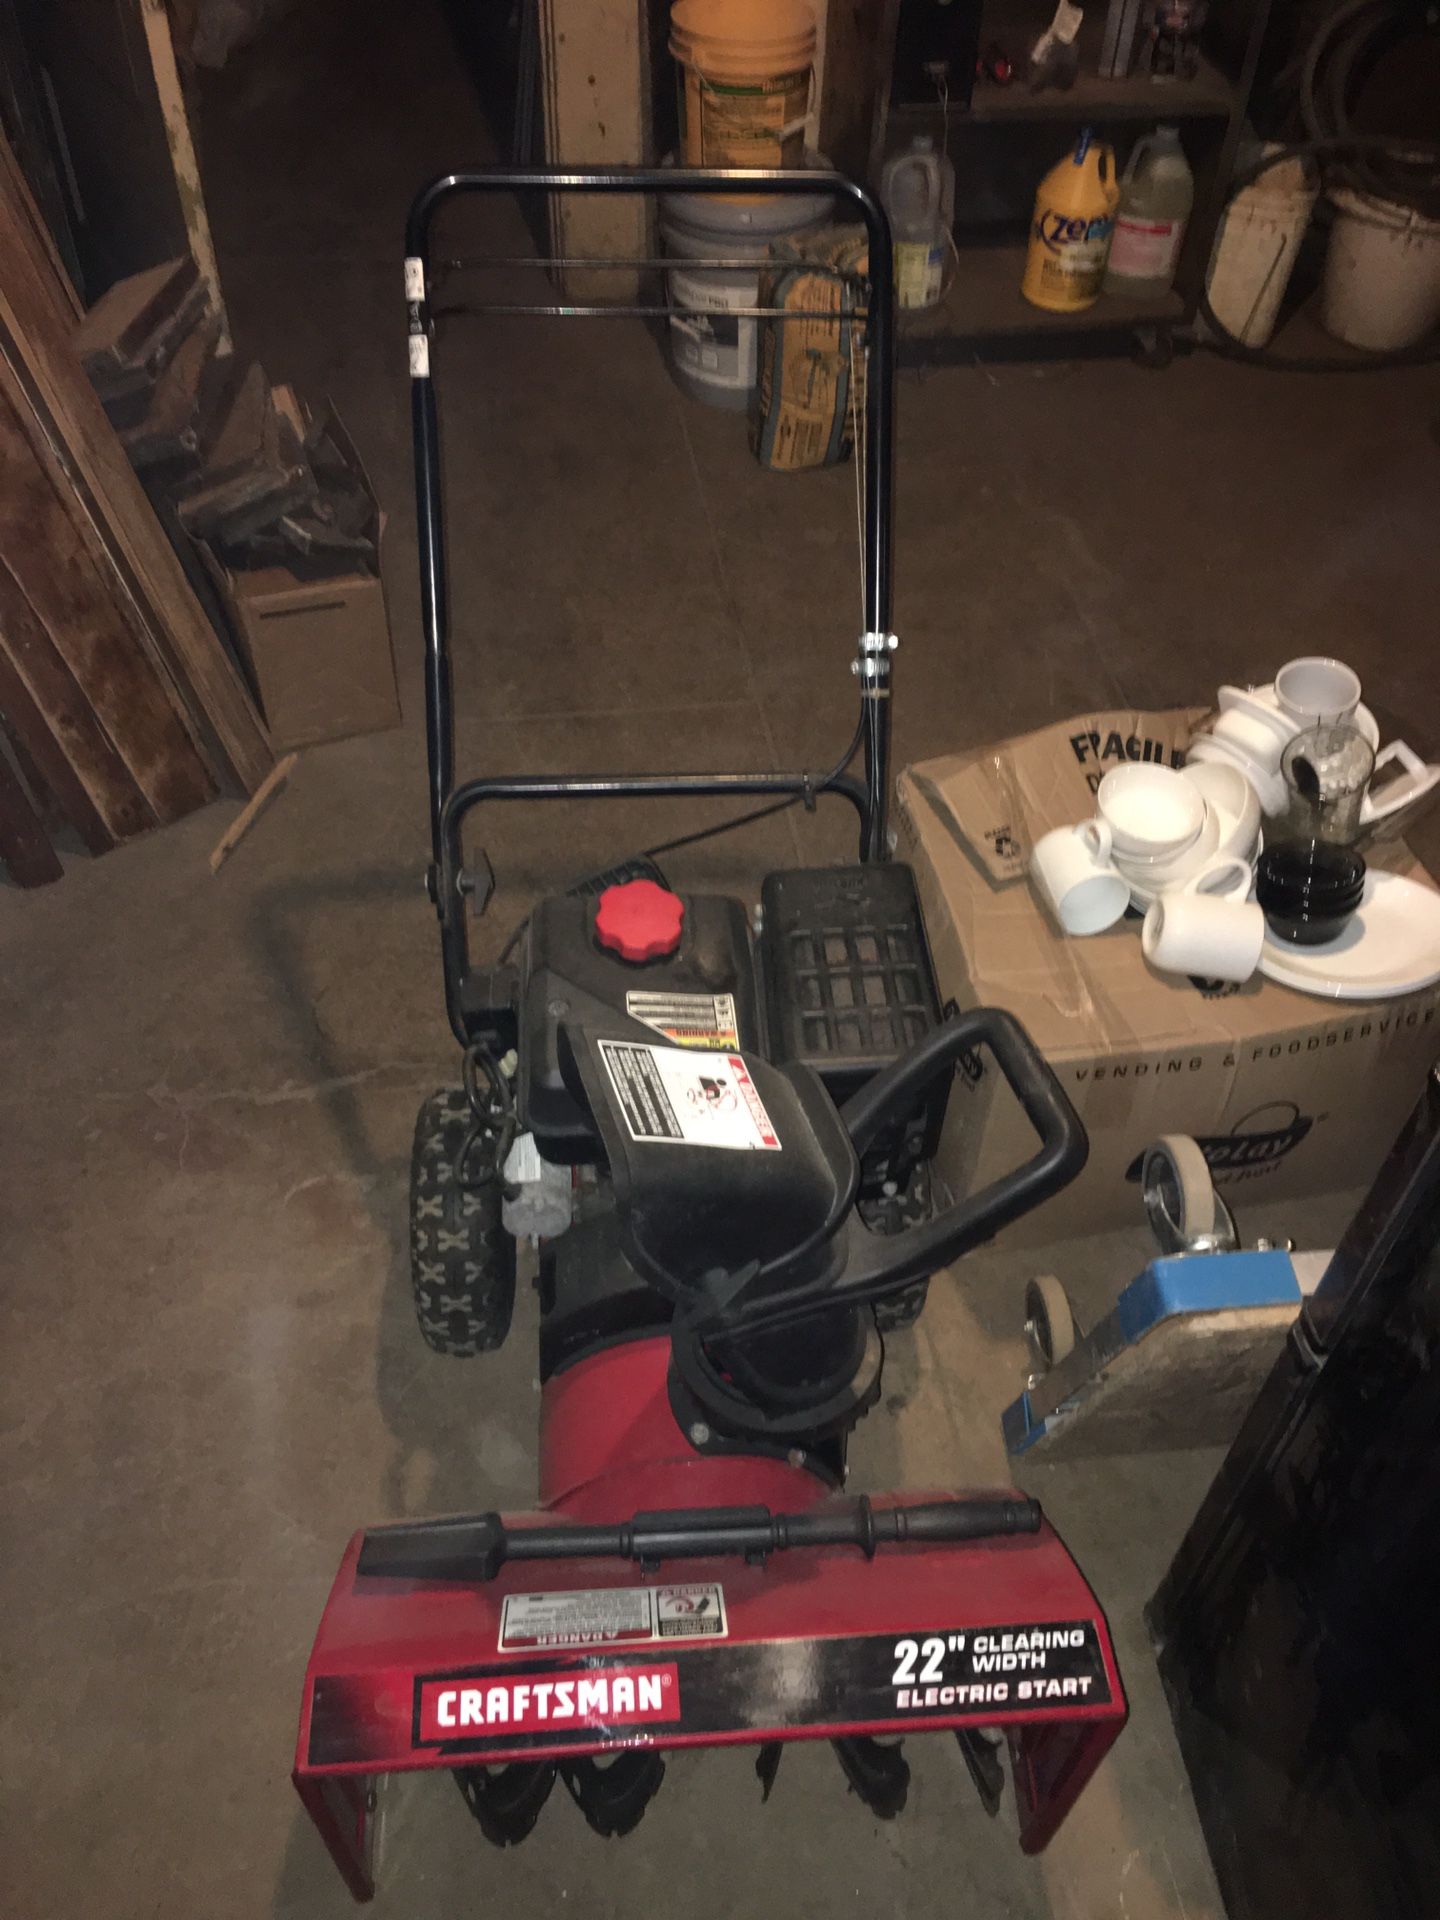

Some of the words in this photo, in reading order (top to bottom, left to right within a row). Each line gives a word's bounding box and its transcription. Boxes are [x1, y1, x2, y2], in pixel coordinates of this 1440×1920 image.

[1075, 1056, 1202, 1082] VENDING
[1222, 1052, 1236, 1067] &
[1252, 1008, 1435, 1062] FOODSERVICE
[536, 1632, 603, 1646] DANGER
[892, 1635, 966, 1685] 22"
[973, 1629, 1085, 1654] CLEARING
[972, 1651, 1046, 1673] WIDTH
[437, 1674, 662, 1728] CRAFTSMAN
[896, 1682, 1009, 1709] ELECTRIC
[1017, 1676, 1092, 1700] START
